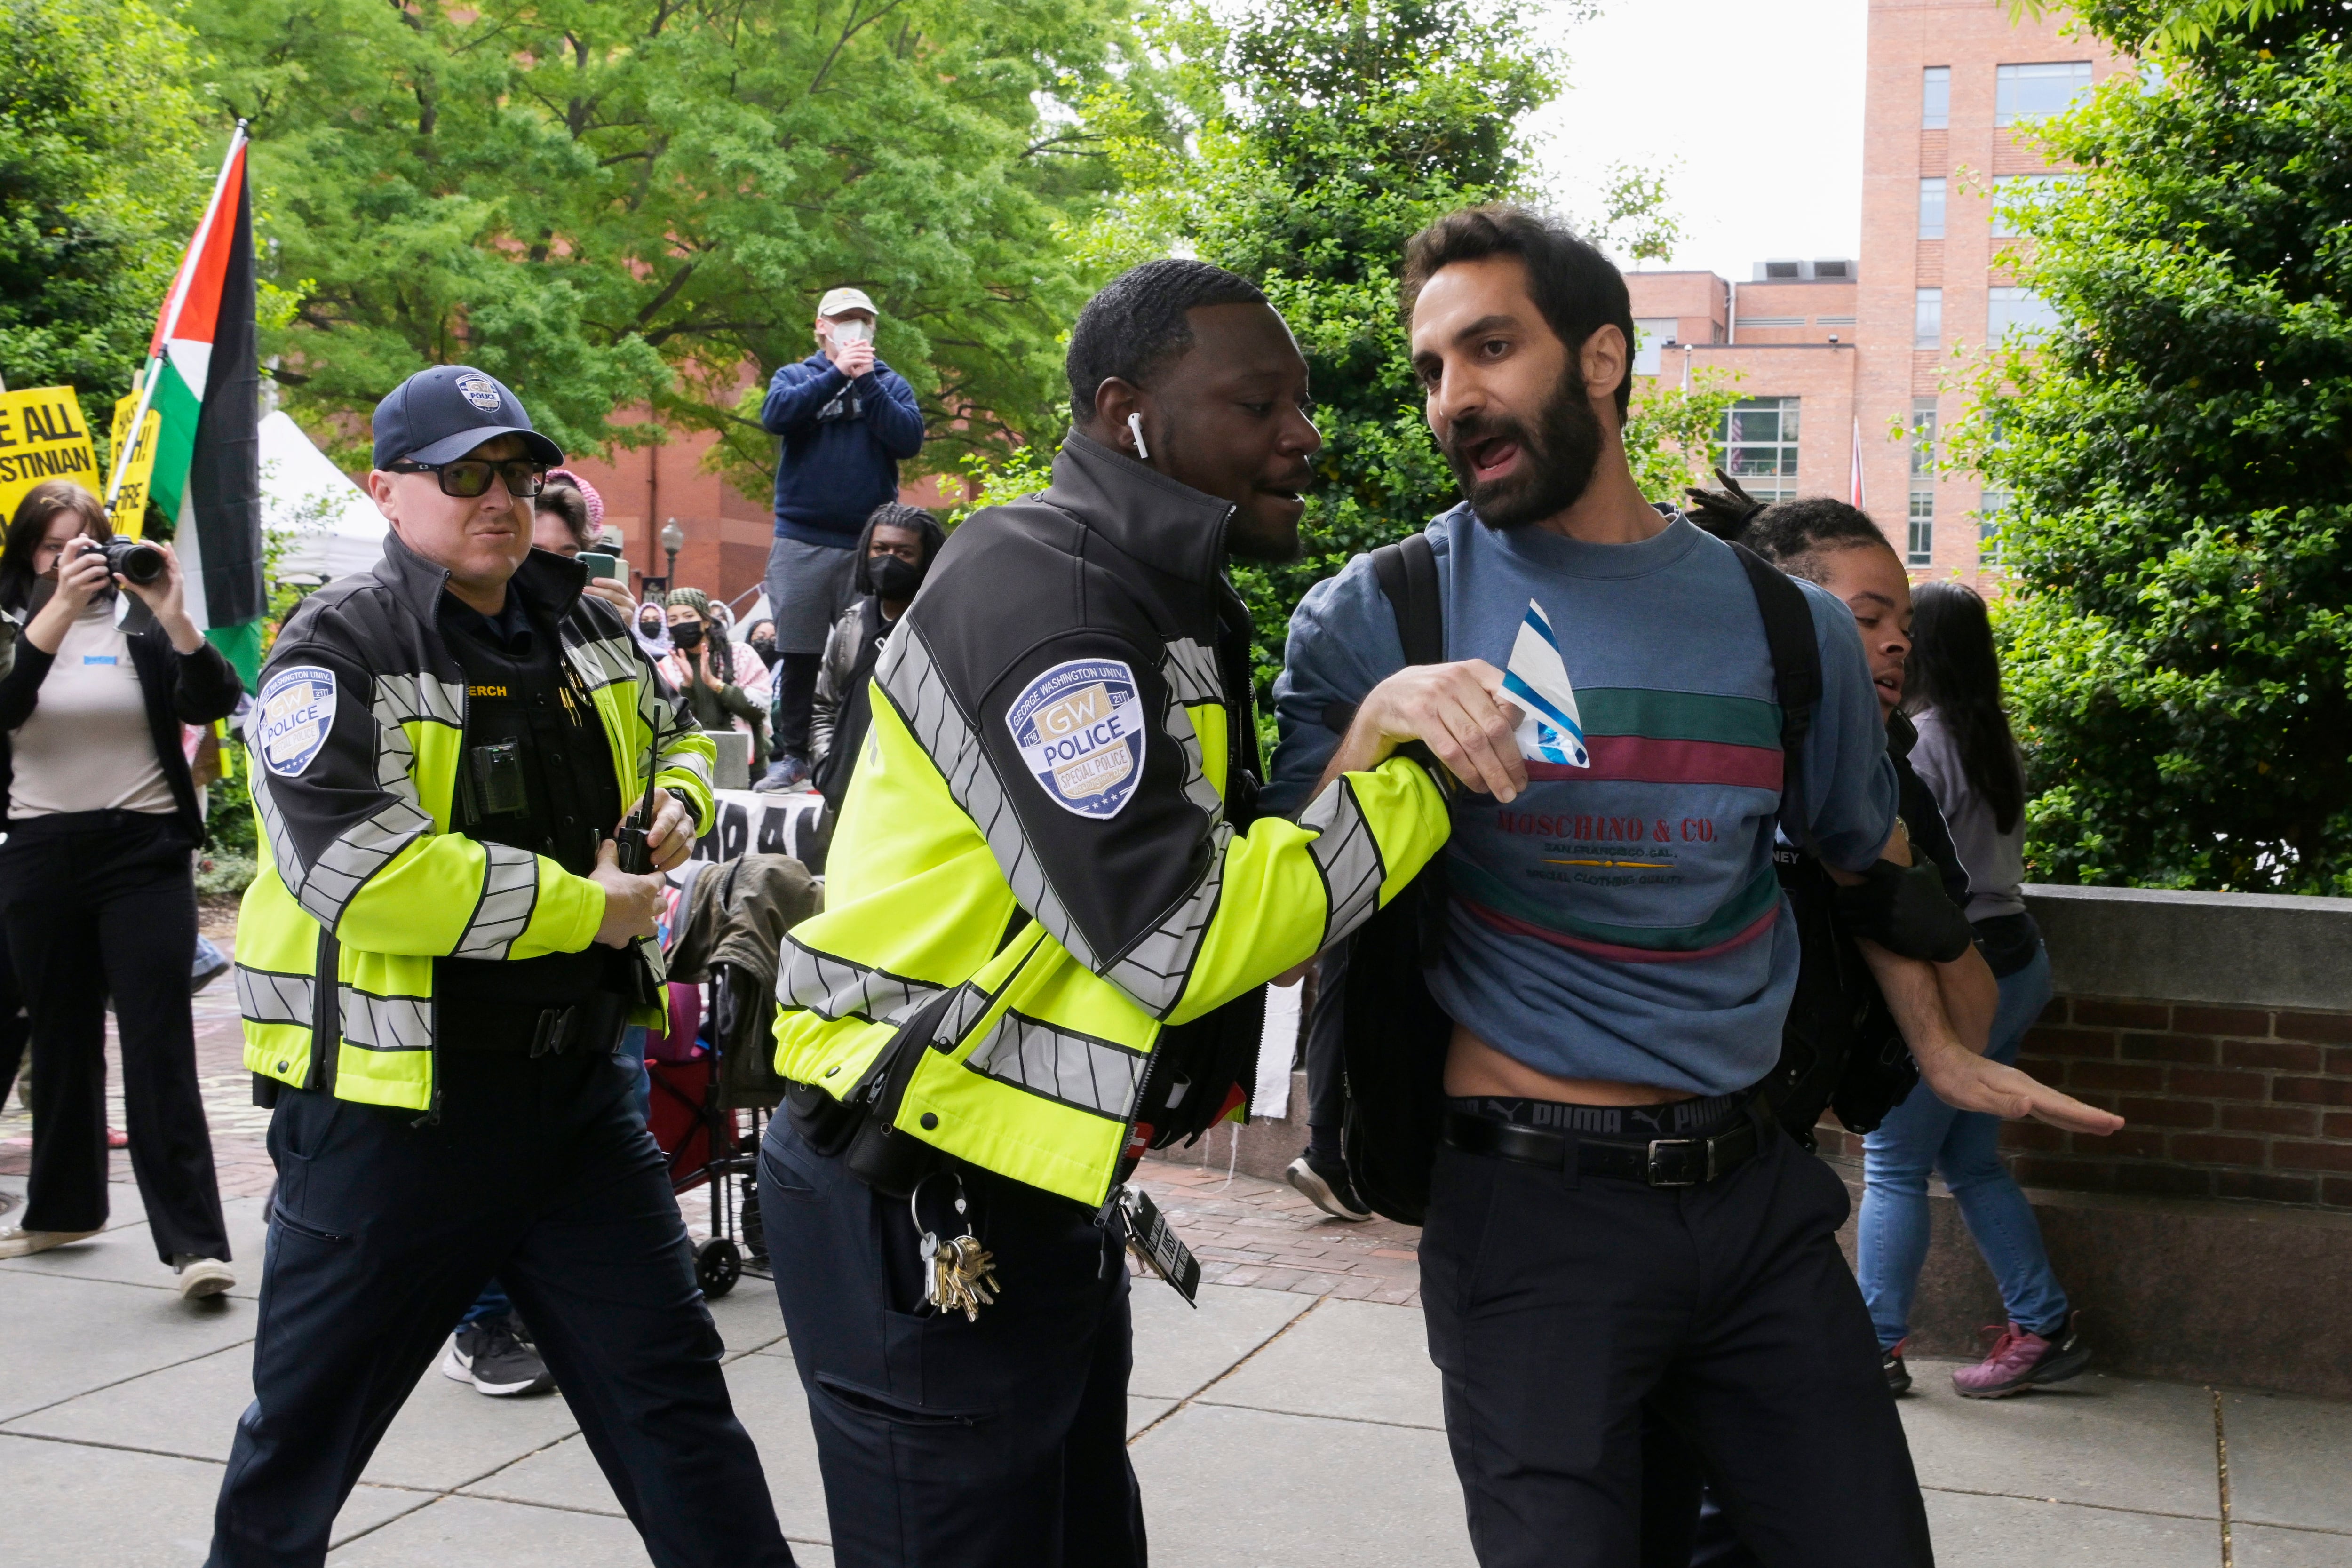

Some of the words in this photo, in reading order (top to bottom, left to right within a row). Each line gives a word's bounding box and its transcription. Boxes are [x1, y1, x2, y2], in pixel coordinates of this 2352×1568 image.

[23, 403, 83, 443] ALL
[270, 672, 309, 692] WASHINGTON
[310, 672, 330, 680] UNIV.
[469, 686, 507, 696] ERCH
[270, 688, 302, 718] GW
[1013, 691, 1040, 727] GEORGE
[1040, 667, 1098, 696] WASHINGTON
[1098, 667, 1126, 678] UNIV.
[1113, 695, 1123, 704] 21
[268, 705, 319, 742] POLICE
[1046, 692, 1096, 735] GW
[293, 727, 316, 743] POLICE
[1029, 733, 1038, 742] 18
[1043, 715, 1125, 767] POLICE
[1061, 763, 1096, 789] SPECIAL
[1095, 750, 1128, 772] POLICE
[1497, 810, 1643, 841] MOSCHINO
[1653, 819, 1671, 842] &
[1681, 818, 1718, 843] CO.
[1772, 851, 1799, 864] NEY
[1526, 869, 1571, 883] SPECIAL
[1573, 872, 1636, 886] CLOTHING
[1638, 875, 1684, 885] QUALITY
[1532, 1103, 1621, 1133] PUMA
[1160, 1248, 1172, 1265] I
[1162, 1228, 1177, 1260] JUST
[1179, 1243, 1190, 1266] HERE
[1174, 1258, 1186, 1282] WORK
